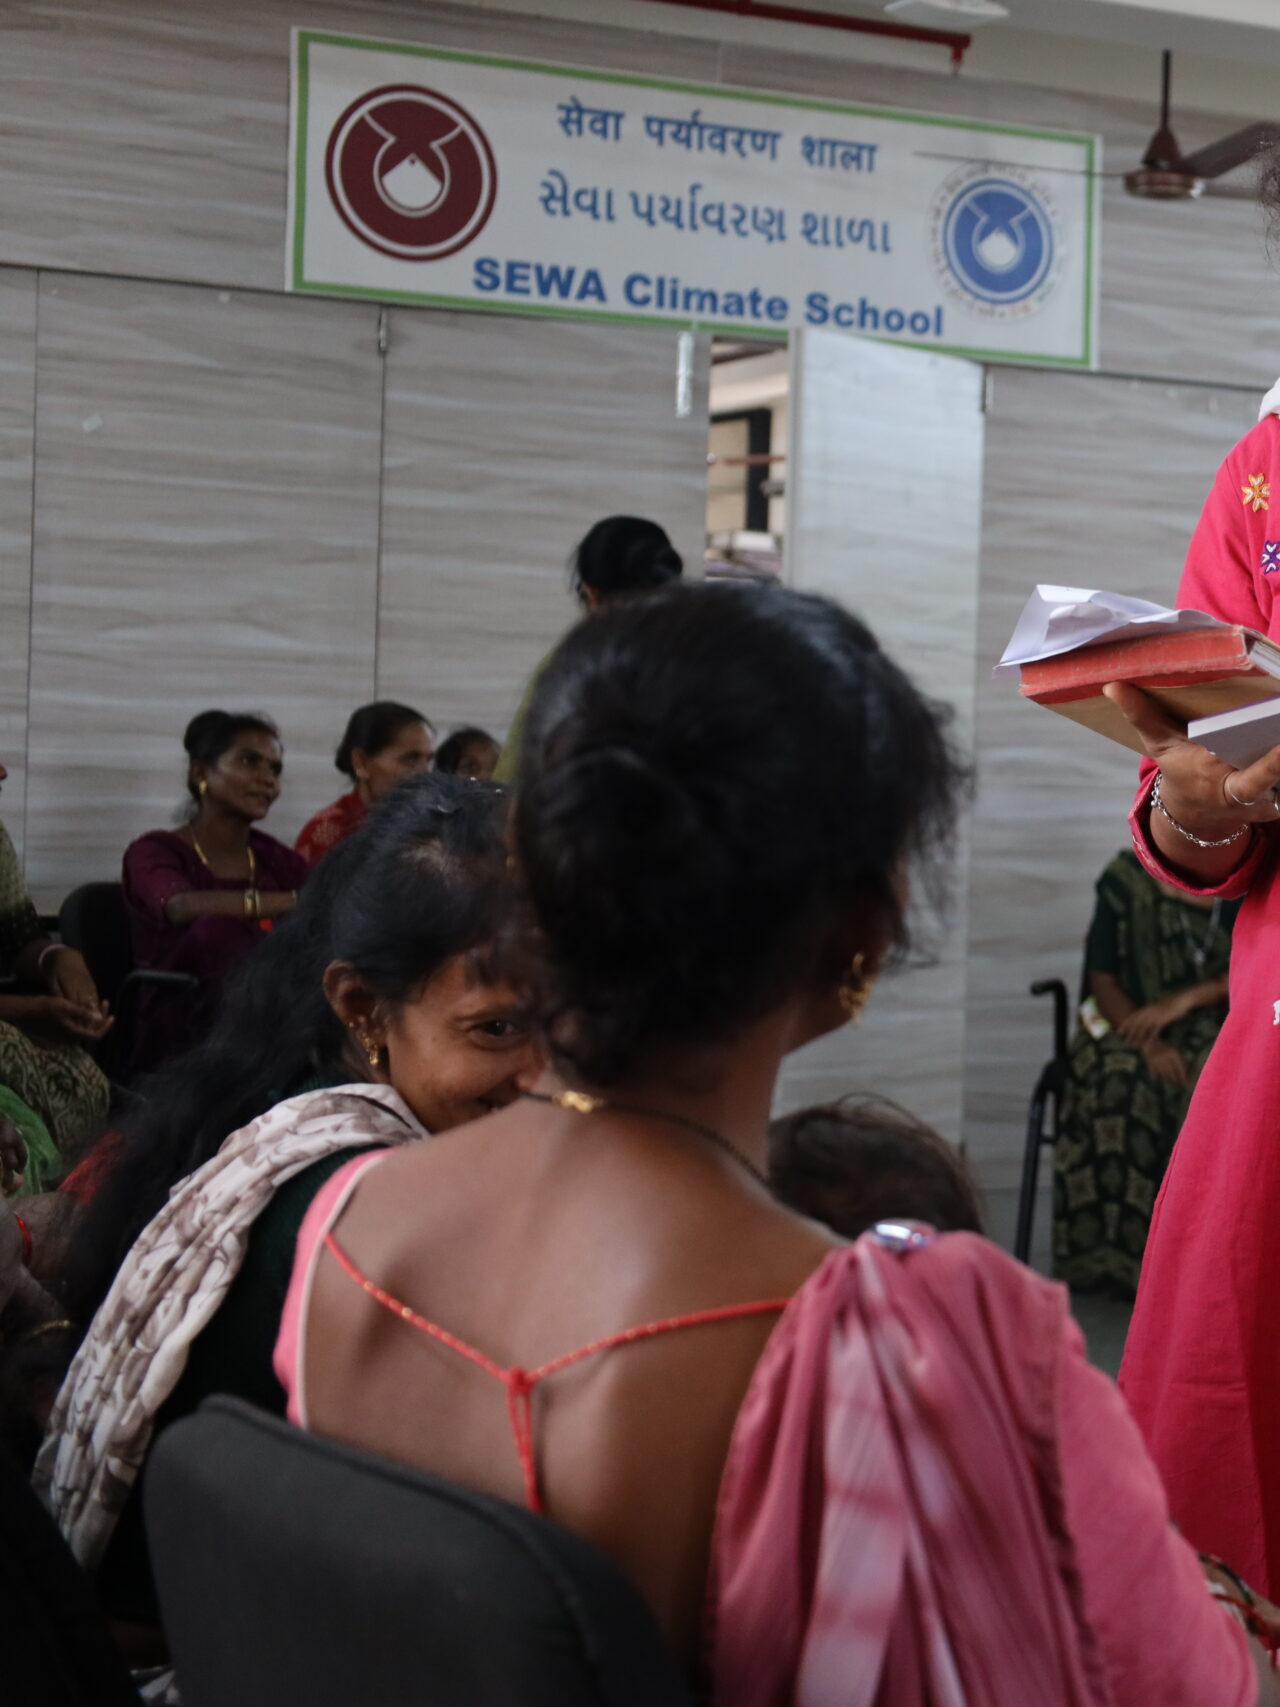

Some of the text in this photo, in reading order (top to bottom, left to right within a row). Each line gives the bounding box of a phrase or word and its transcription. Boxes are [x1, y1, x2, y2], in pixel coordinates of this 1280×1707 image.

[557, 95, 879, 173] सेवा पर्यावरण शाला
[539, 169, 892, 254] સેવા પર્યાવરણ શાળા
[473, 257, 944, 336] SEWA Climate School
